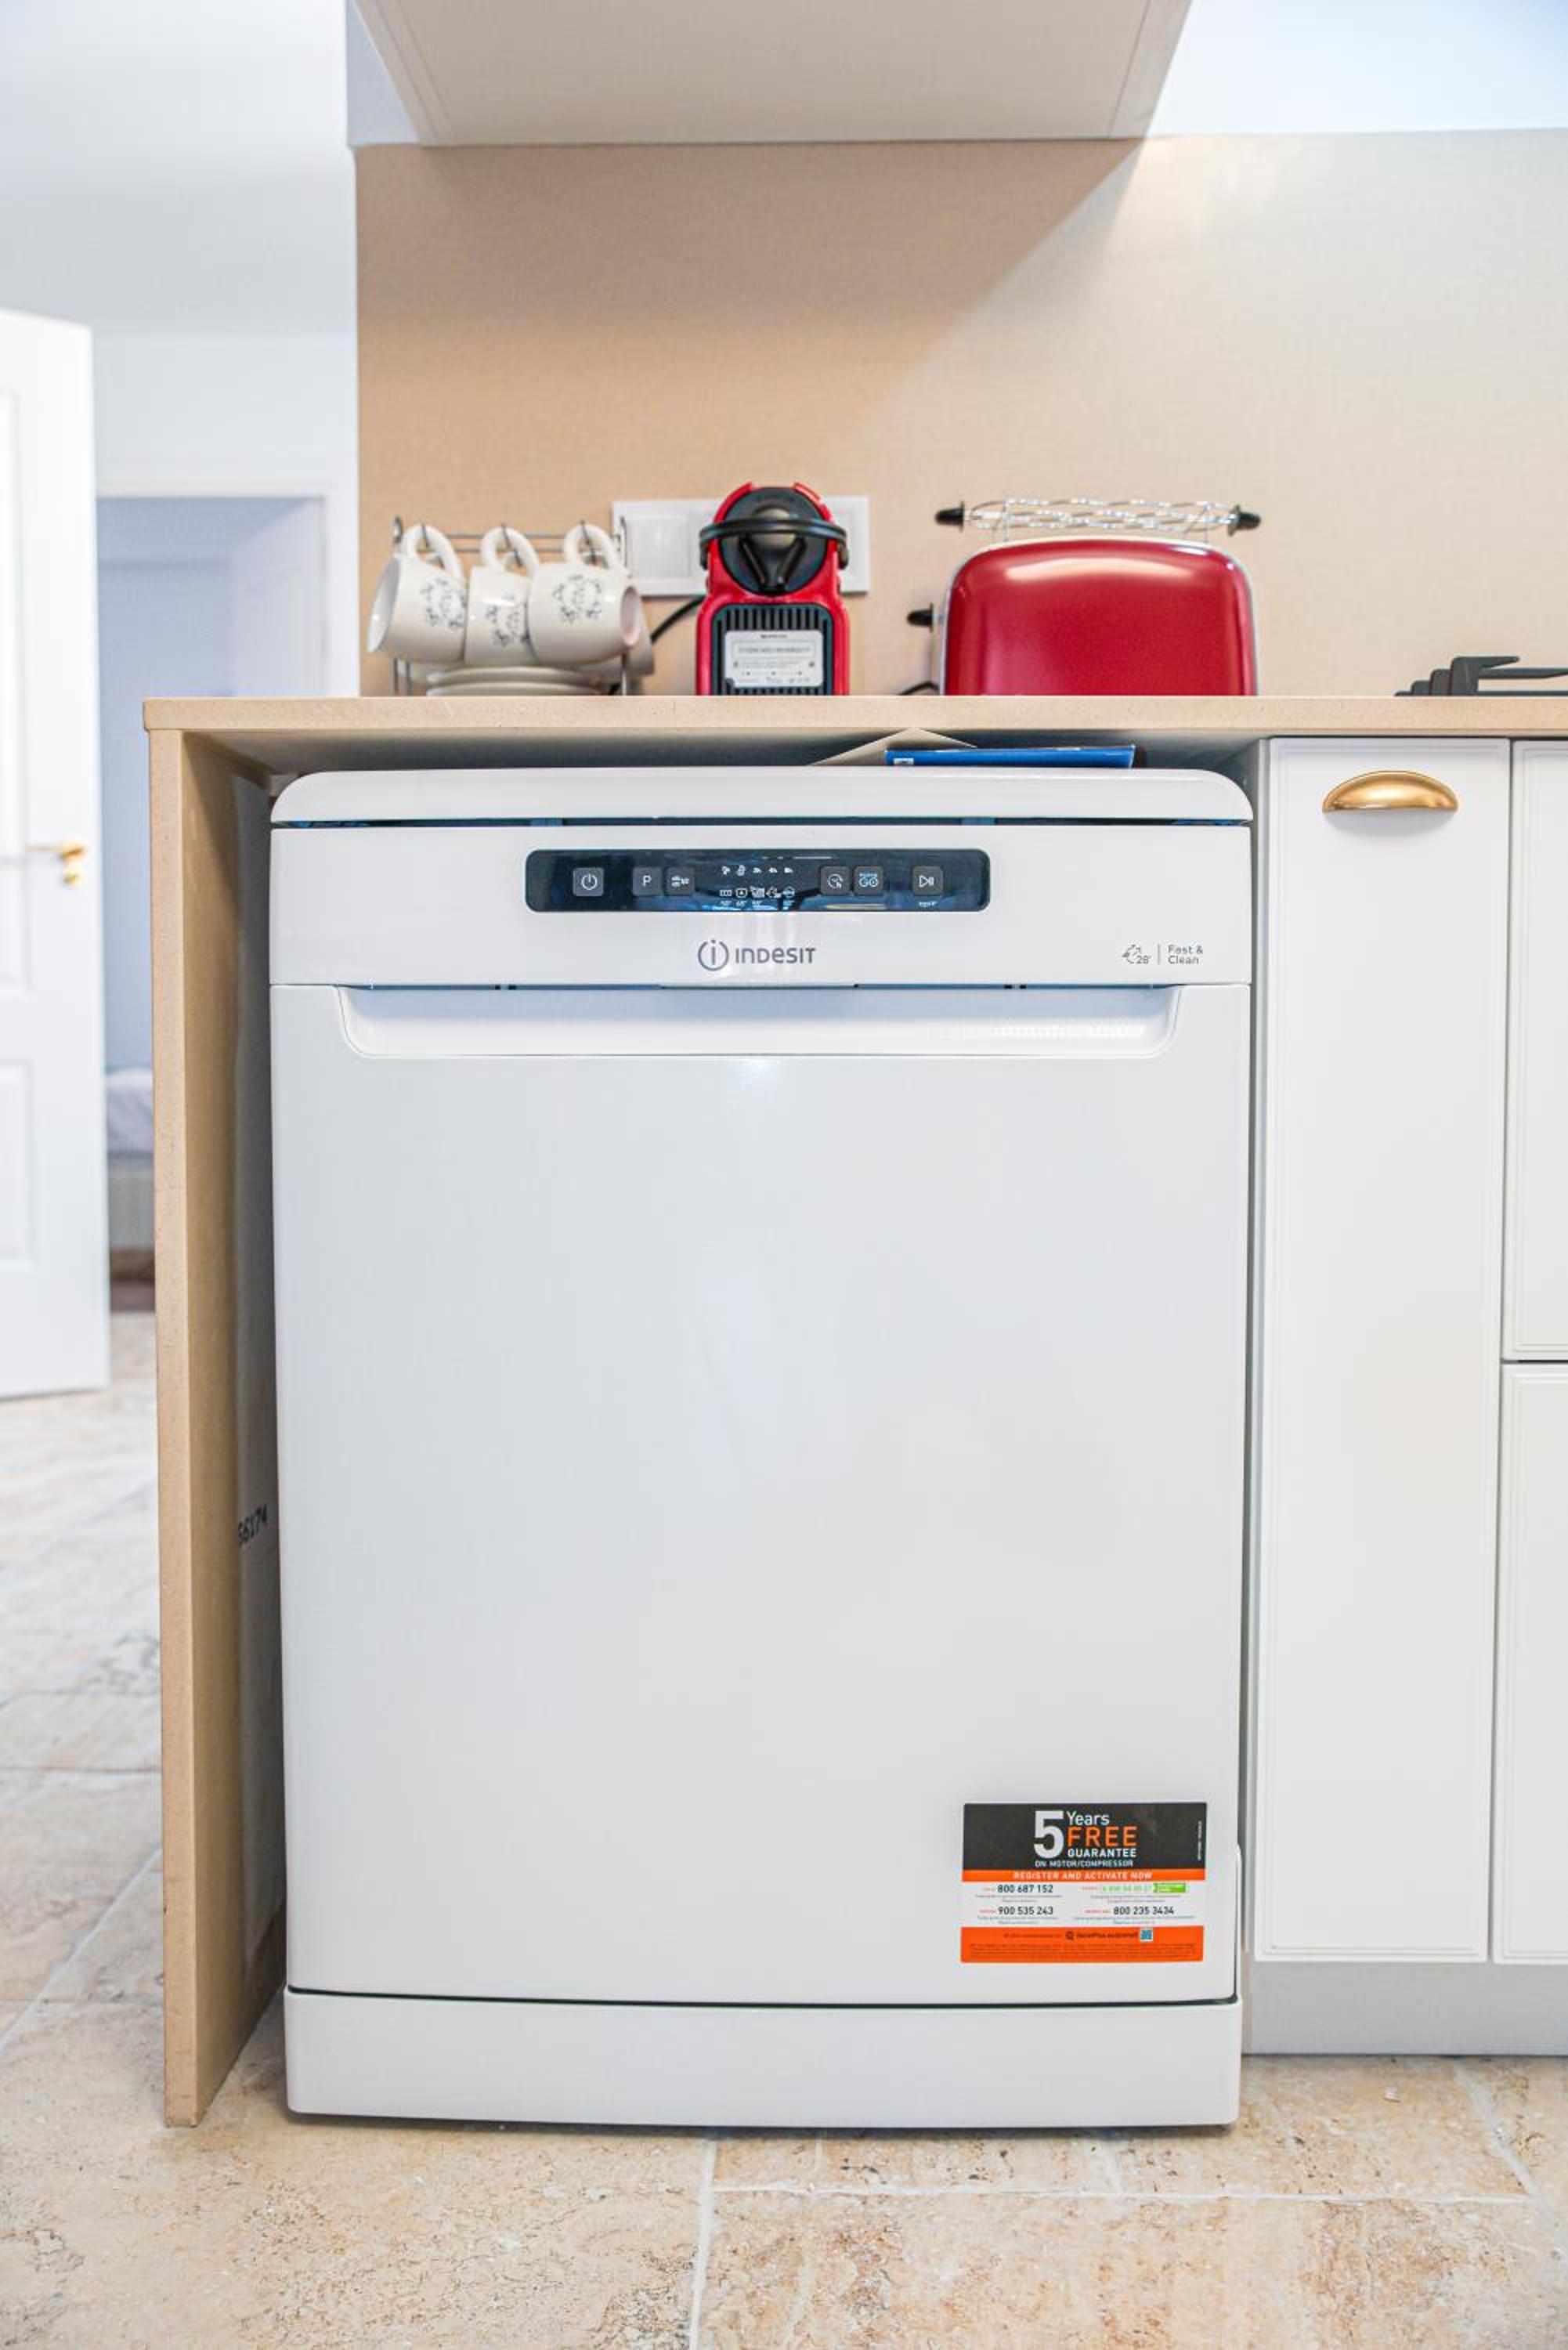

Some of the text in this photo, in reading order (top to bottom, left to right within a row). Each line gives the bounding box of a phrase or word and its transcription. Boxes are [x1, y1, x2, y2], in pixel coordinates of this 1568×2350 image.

[642, 875, 652, 887] P
[1167, 944, 1204, 954] Fast &
[1167, 955, 1200, 964] Clean
[1066, 1810, 1110, 1826] Years
[1033, 1810, 1064, 1859] 5
[1068, 1826, 1138, 1847] FREE
[1068, 1848, 1137, 1857] GUARANTEE
[1013, 1871, 1152, 1880] REGISTER AND ACTIVATE NOW
[997, 1884, 1015, 1893] 800
[1017, 1884, 1035, 1893] 687
[1038, 1884, 1053, 1893] 152
[1113, 1906, 1130, 1914] 800
[1133, 1906, 1150, 1914] 235
[1152, 1906, 1175, 1914] 3434
